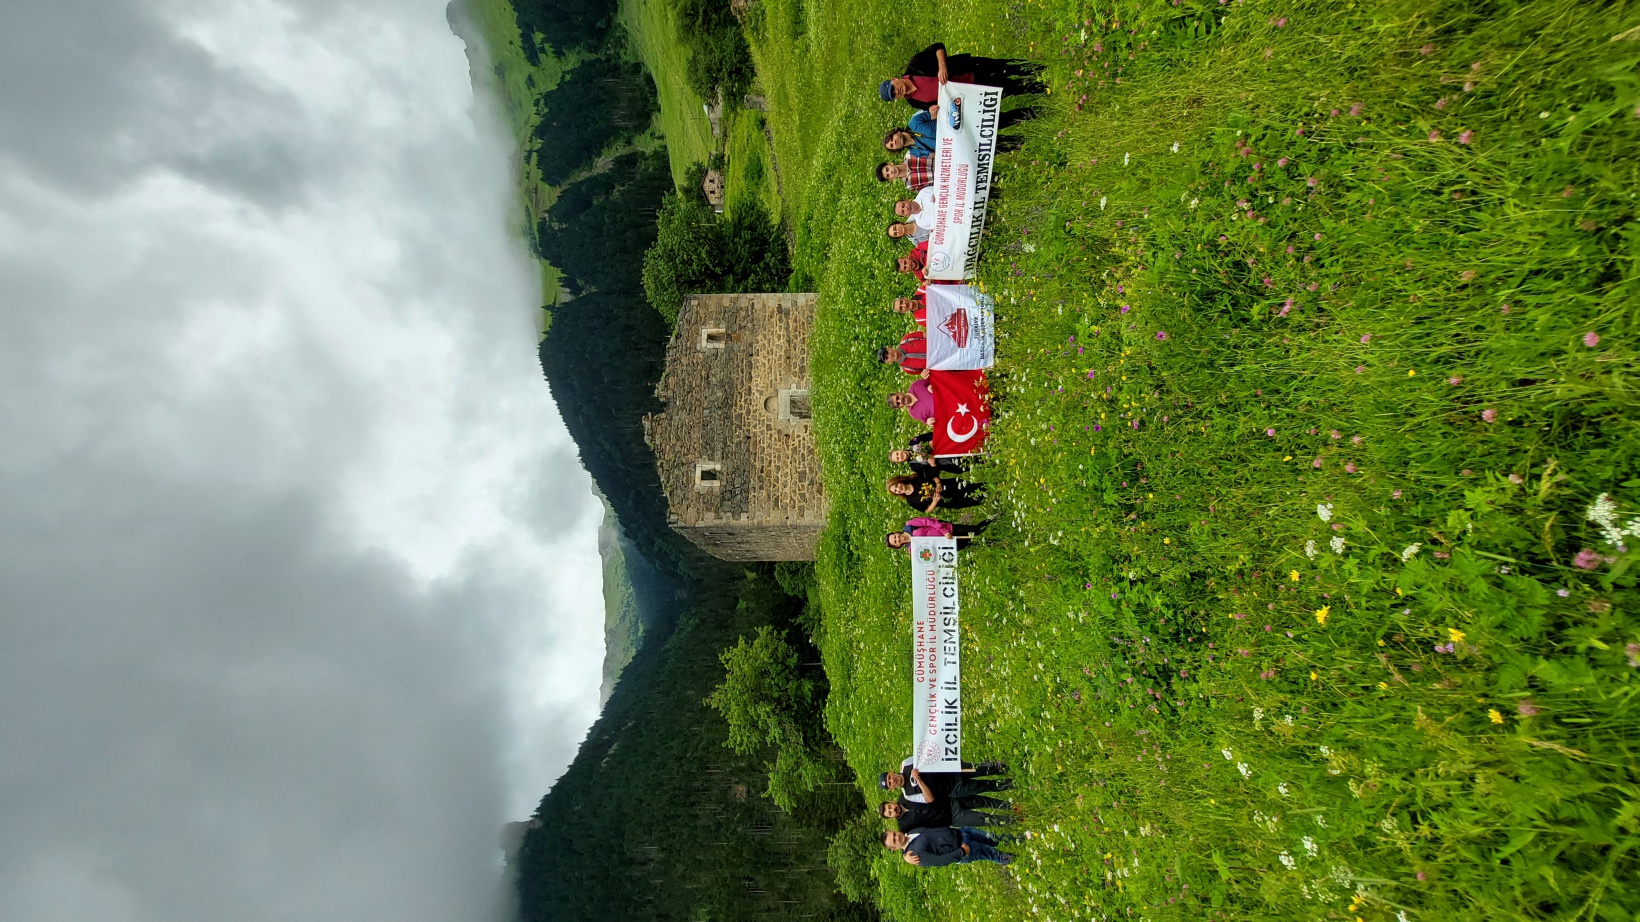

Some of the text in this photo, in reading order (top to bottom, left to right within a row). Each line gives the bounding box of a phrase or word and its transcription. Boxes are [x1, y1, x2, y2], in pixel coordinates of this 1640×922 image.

[933, 137, 952, 245] GÜMÜŞHANE GENÇLİK HİZMETLERİ VE
[954, 164, 968, 201] MÜDÜRLÜĞÜ
[963, 91, 998, 272] DAĞCILIK İL TEMSİLCİLİĞİ
[953, 210, 964, 225] SPOR
[926, 570, 936, 632] MÜDÜRLÜĞÜ
[915, 621, 927, 683] GÜMÜŞHANE
[927, 636, 936, 644] İL
[938, 546, 958, 761] İZCİLİK İL TEMSİLCİLİĞİ
[929, 677, 936, 689] VE
[927, 693, 939, 736] GENÇLİK
